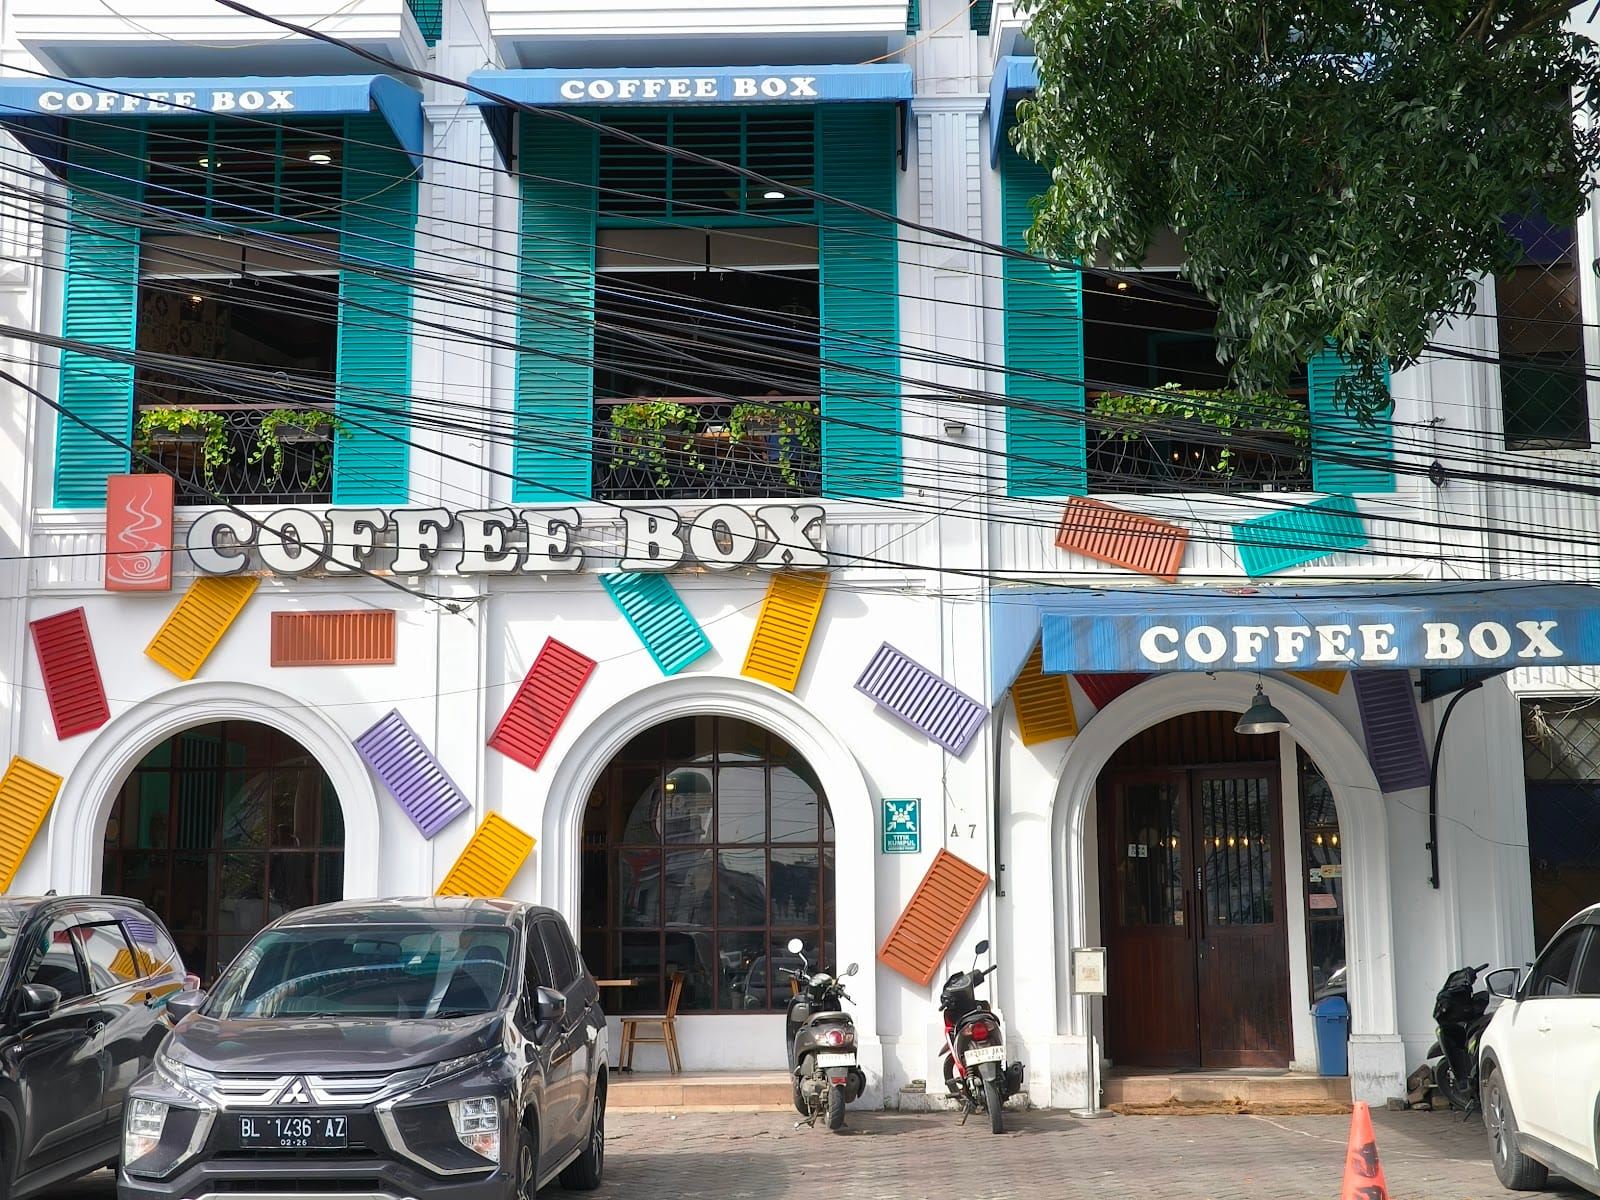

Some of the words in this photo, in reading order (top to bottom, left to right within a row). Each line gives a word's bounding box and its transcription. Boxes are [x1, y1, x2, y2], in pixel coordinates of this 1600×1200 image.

[560, 78, 718, 99] COFFEE
[733, 77, 818, 97] BOX
[38, 91, 196, 111] COFFEE
[211, 90, 294, 110] BOX
[186, 507, 586, 575] COFFEE
[619, 504, 832, 571] BOX
[1139, 623, 1399, 663] COFFEE
[1422, 620, 1564, 660] BOX
[950, 823, 959, 837] A
[968, 824, 977, 838] 7
[241, 1118, 260, 1137] BL
[275, 1118, 312, 1137] 1436
[325, 1118, 345, 1137] AZ
